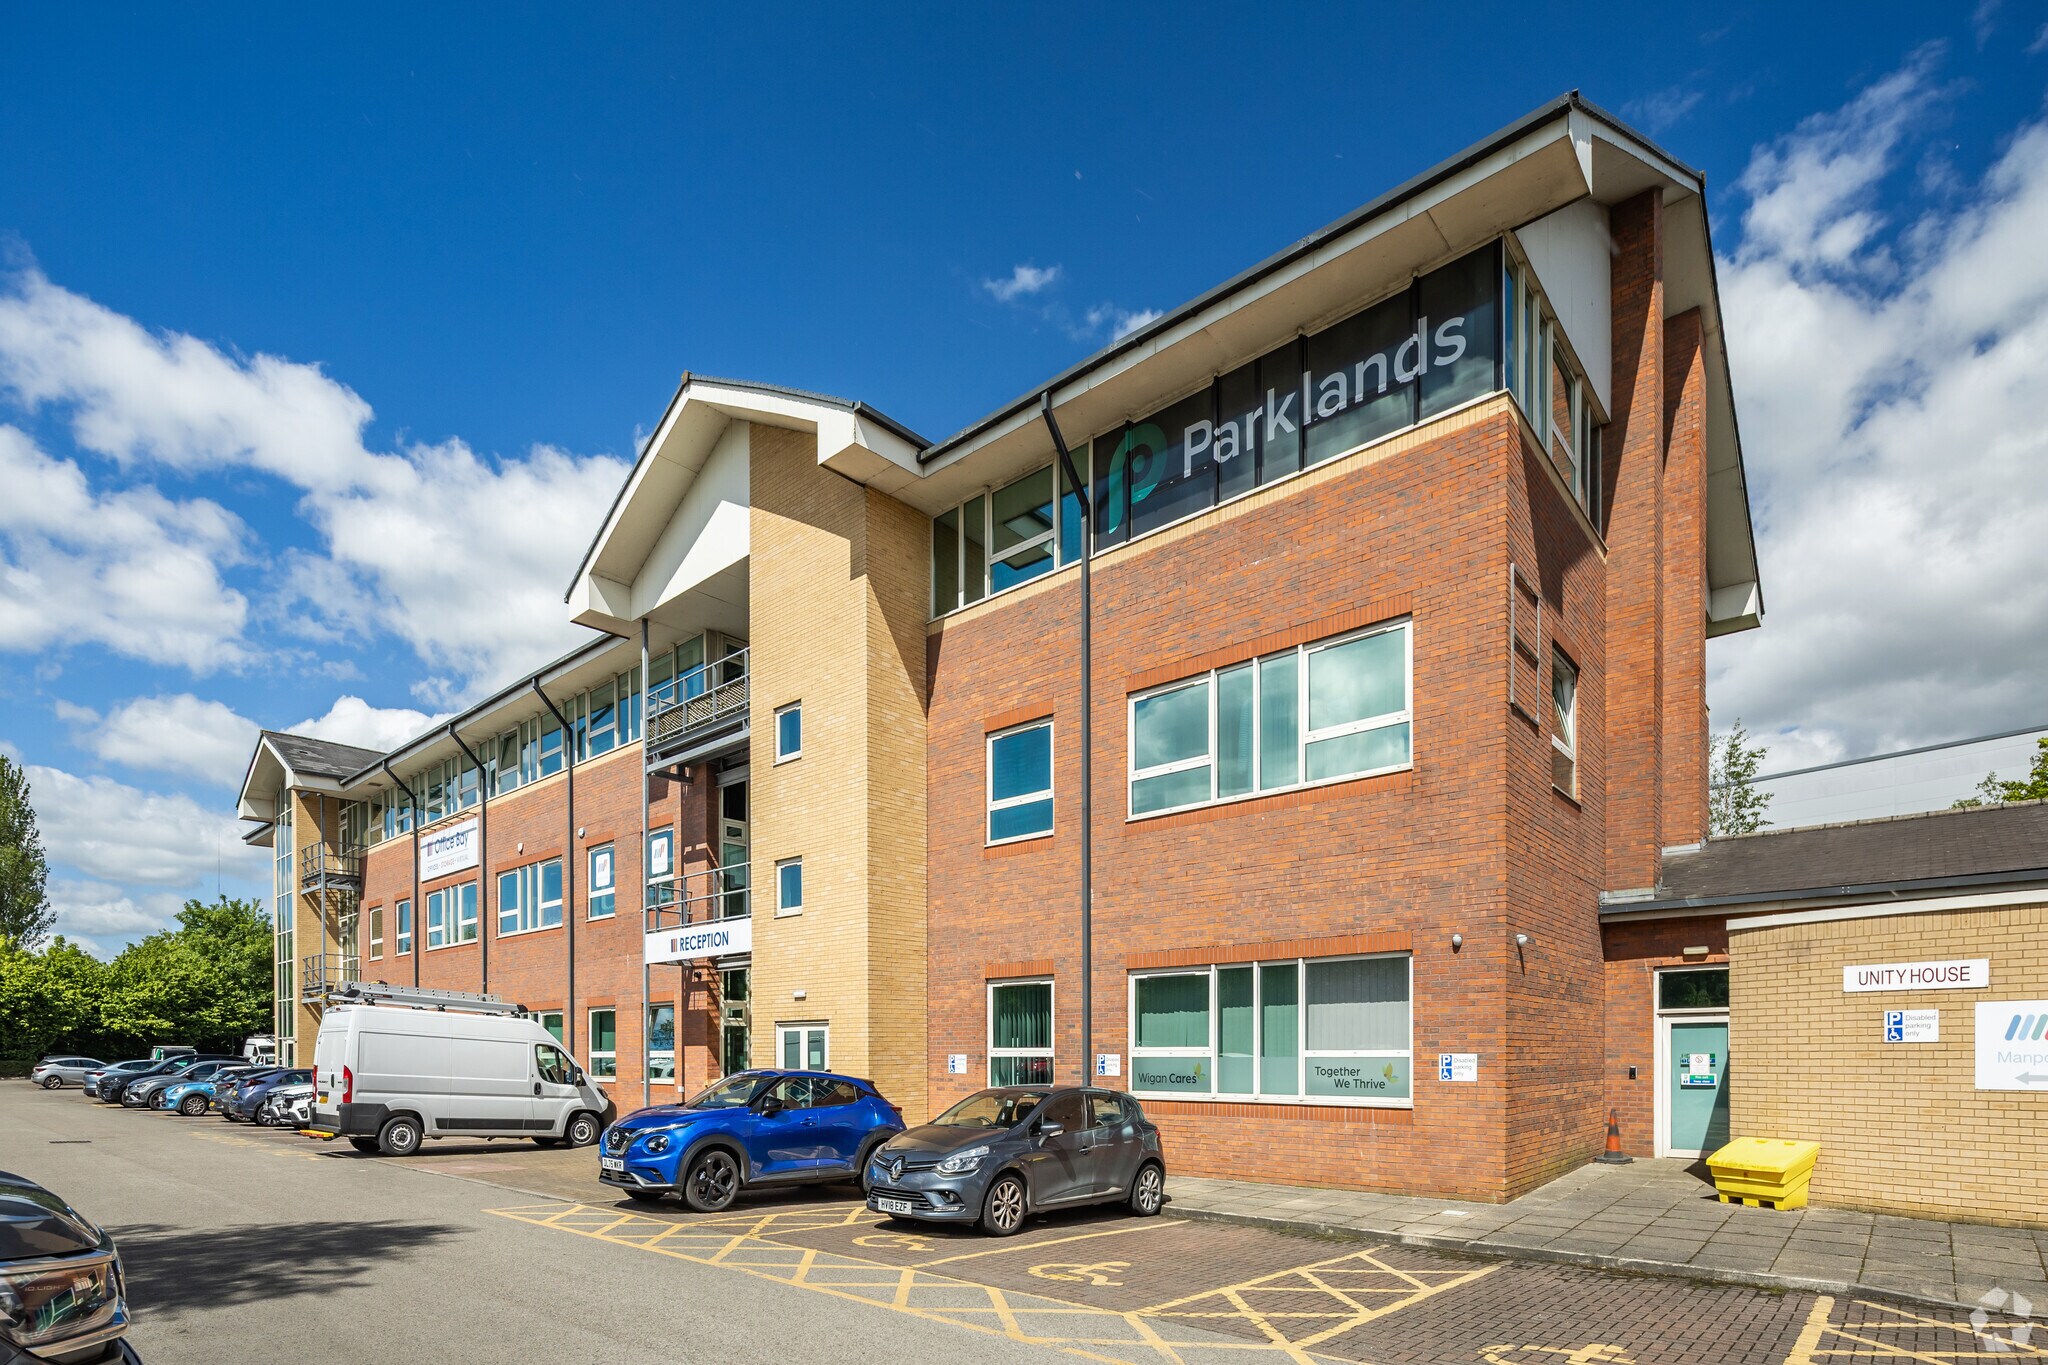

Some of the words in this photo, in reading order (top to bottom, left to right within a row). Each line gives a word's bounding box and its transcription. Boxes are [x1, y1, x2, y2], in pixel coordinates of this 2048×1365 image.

[1183, 316, 1467, 479] Parklands
[434, 836, 454, 853] Office
[680, 931, 729, 951] RECEPTION
[1858, 969, 1907, 986] UNITY
[1910, 966, 1971, 983] HOUSE
[1138, 1073, 1167, 1085] Wigan
[1169, 1073, 1197, 1084] Cares
[1315, 1066, 1360, 1078] Together
[1334, 1079, 1350, 1088] We
[1353, 1079, 1385, 1089] Thrive
[881, 1200, 894, 1210] HV18
[895, 1202, 907, 1211] EZF
